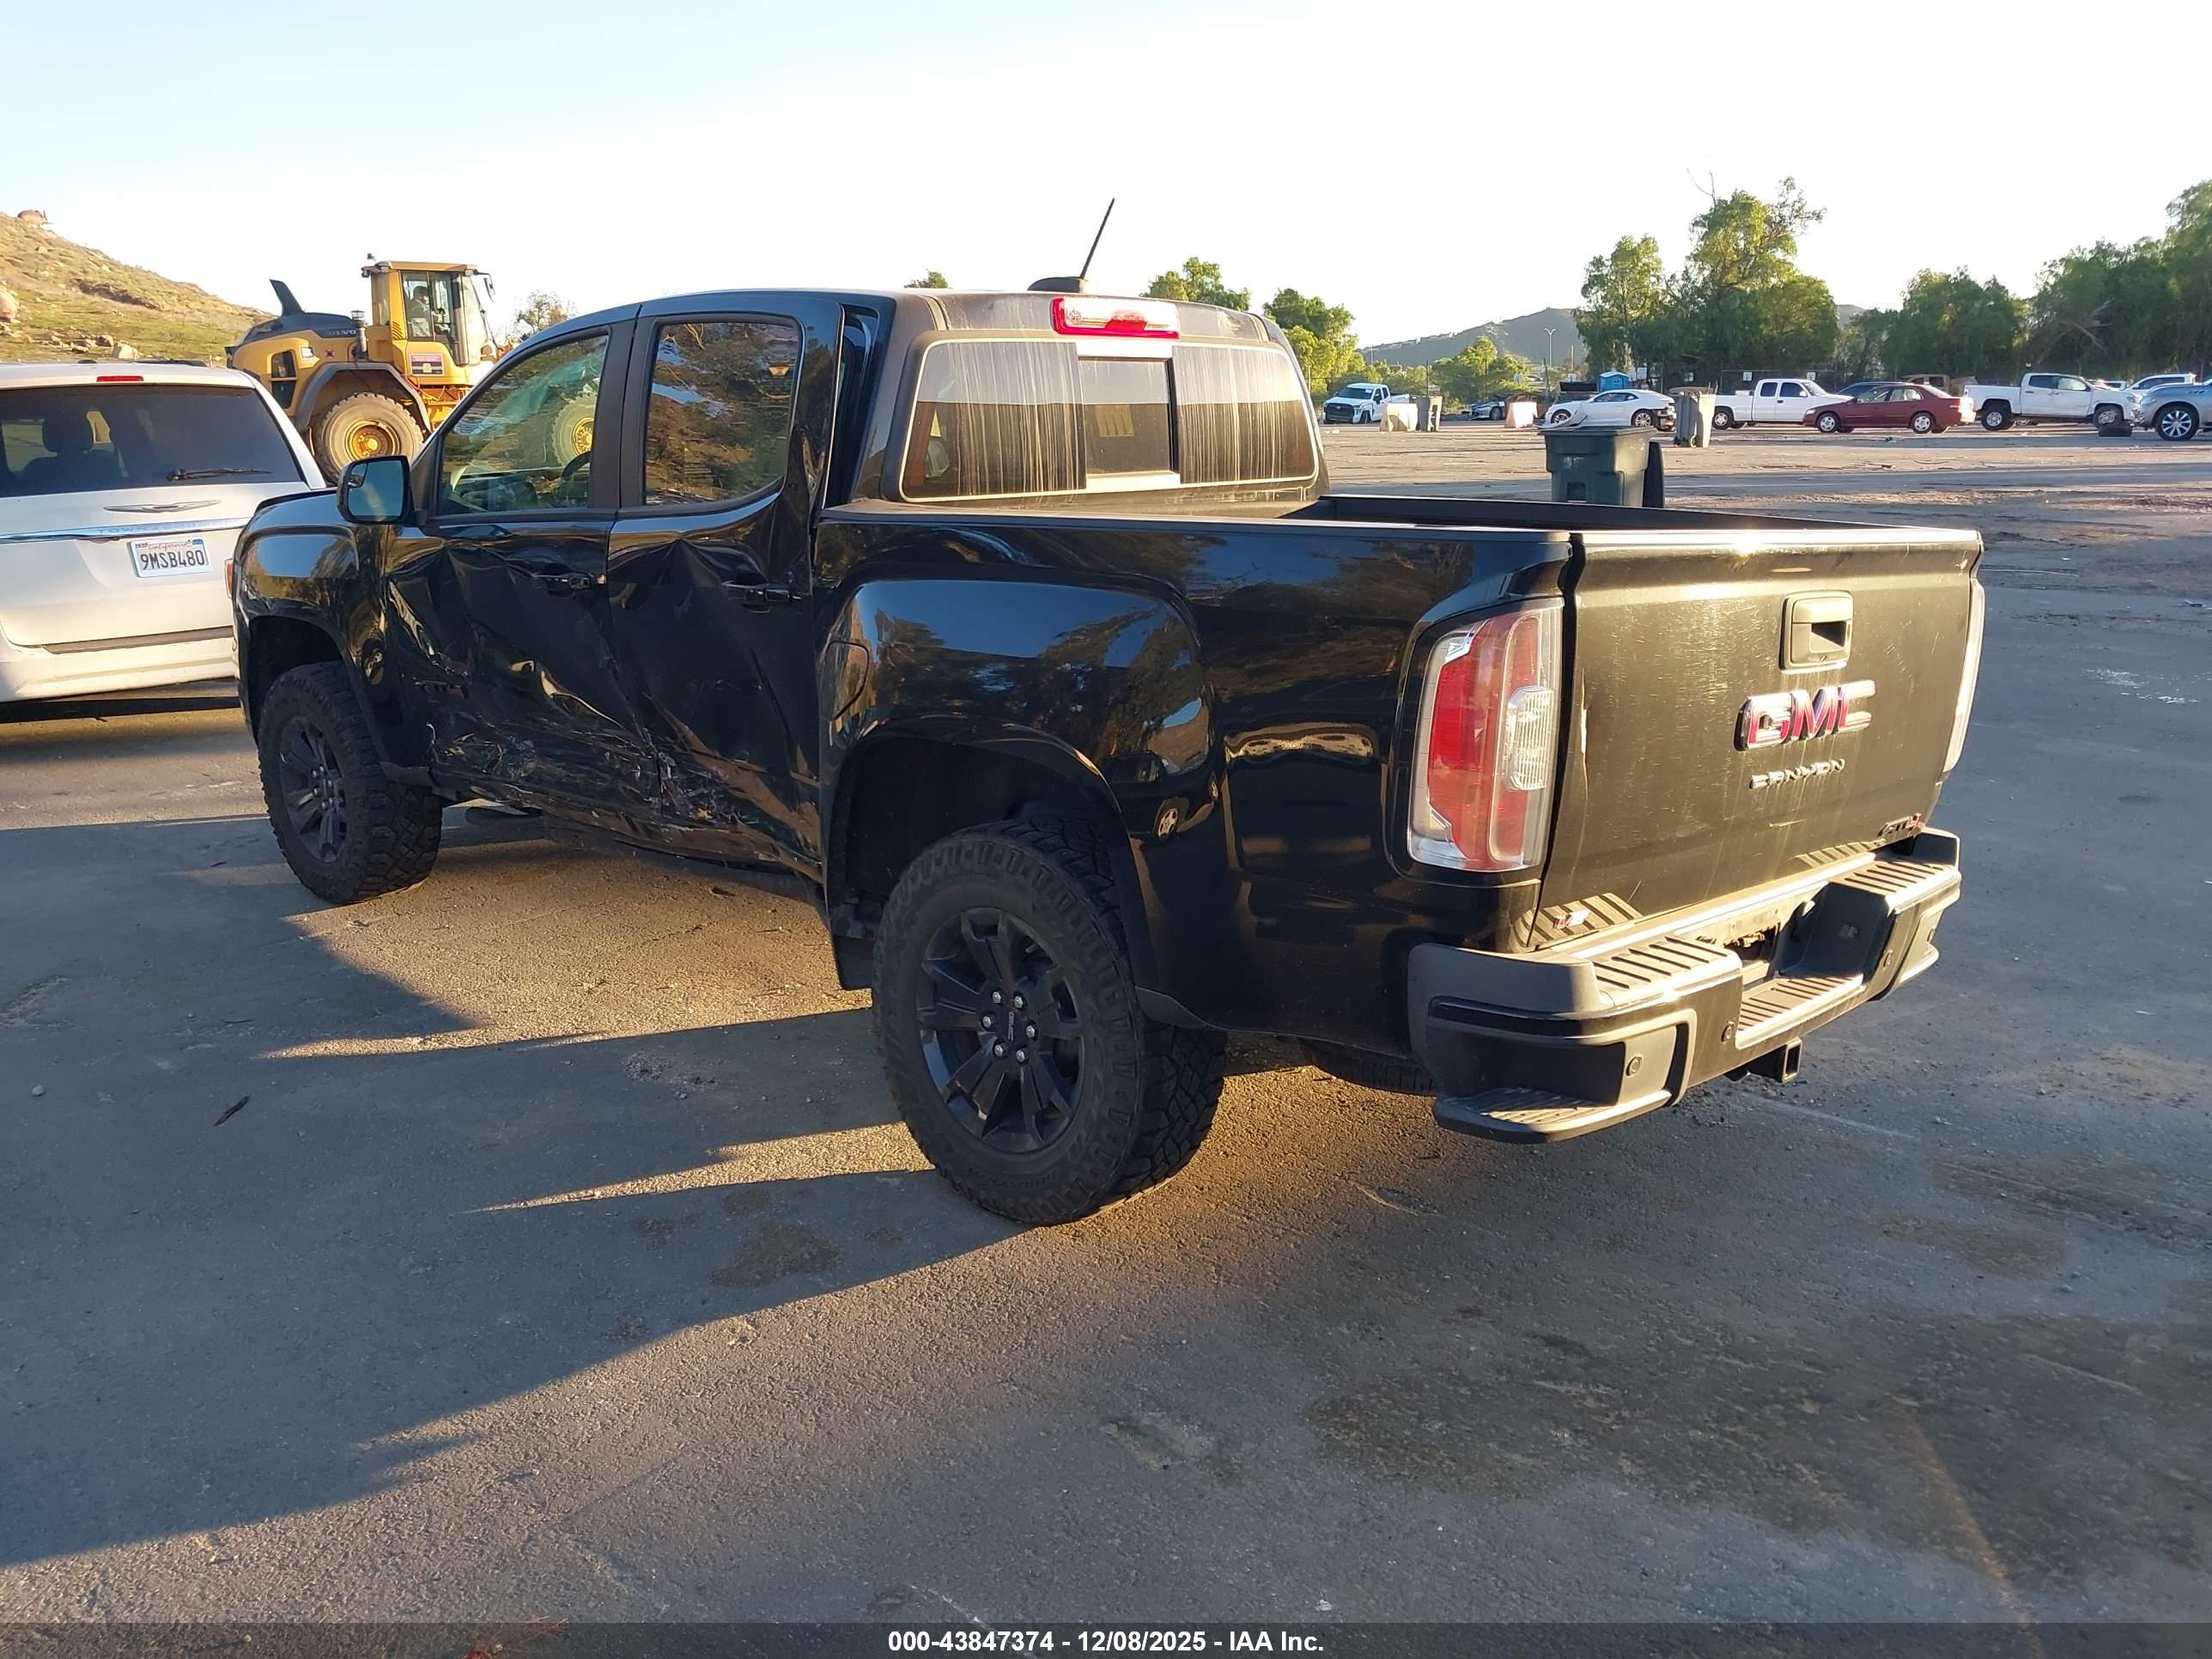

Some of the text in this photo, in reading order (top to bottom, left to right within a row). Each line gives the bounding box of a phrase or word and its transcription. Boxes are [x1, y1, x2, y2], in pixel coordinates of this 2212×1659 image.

[96, 526, 146, 534] TOWN
[148, 542, 188, 551] California
[140, 550, 205, 570] 9MSB480
[1734, 679, 1875, 751] GMC
